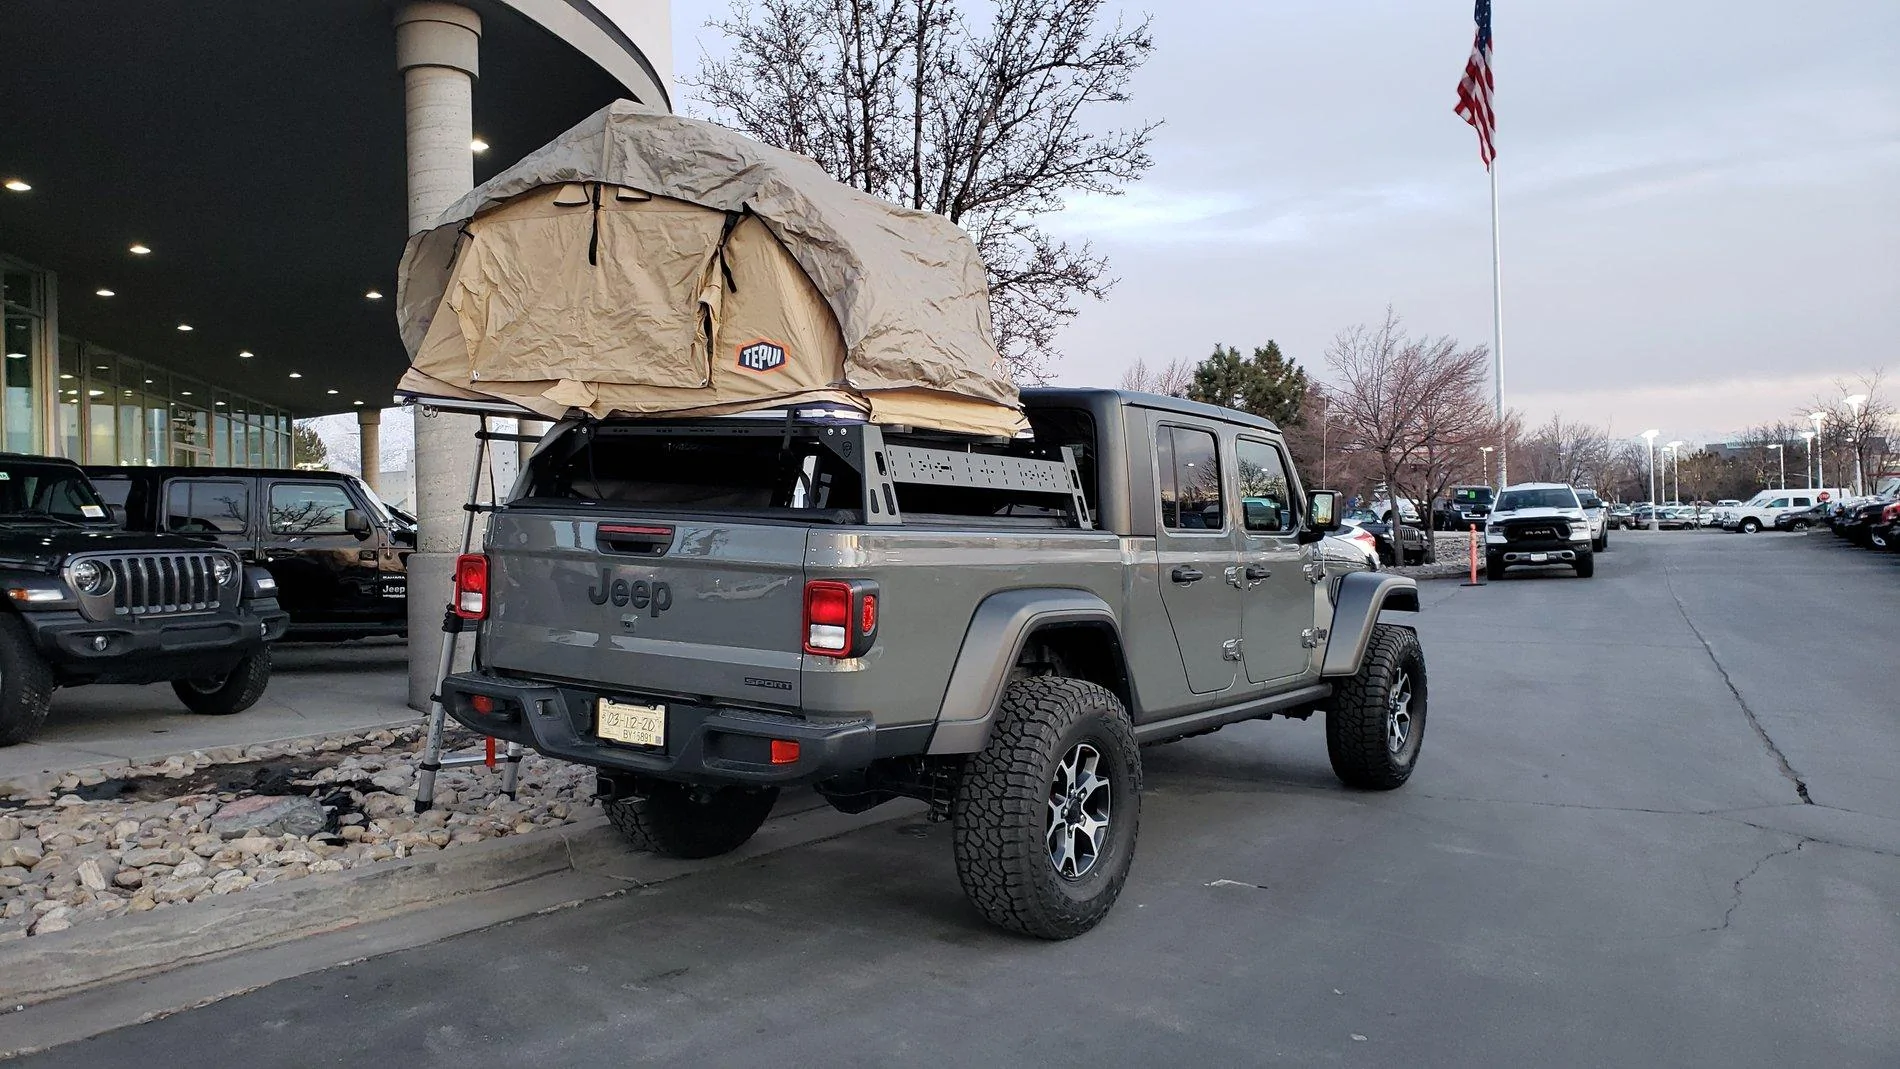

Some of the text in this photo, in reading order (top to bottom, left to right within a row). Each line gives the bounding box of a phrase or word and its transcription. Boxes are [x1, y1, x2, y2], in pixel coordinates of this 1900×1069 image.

[743, 344, 782, 370] TEPUI
[382, 585, 406, 594] Jeep
[588, 567, 673, 618] Jeep
[744, 677, 792, 690] SPORT
